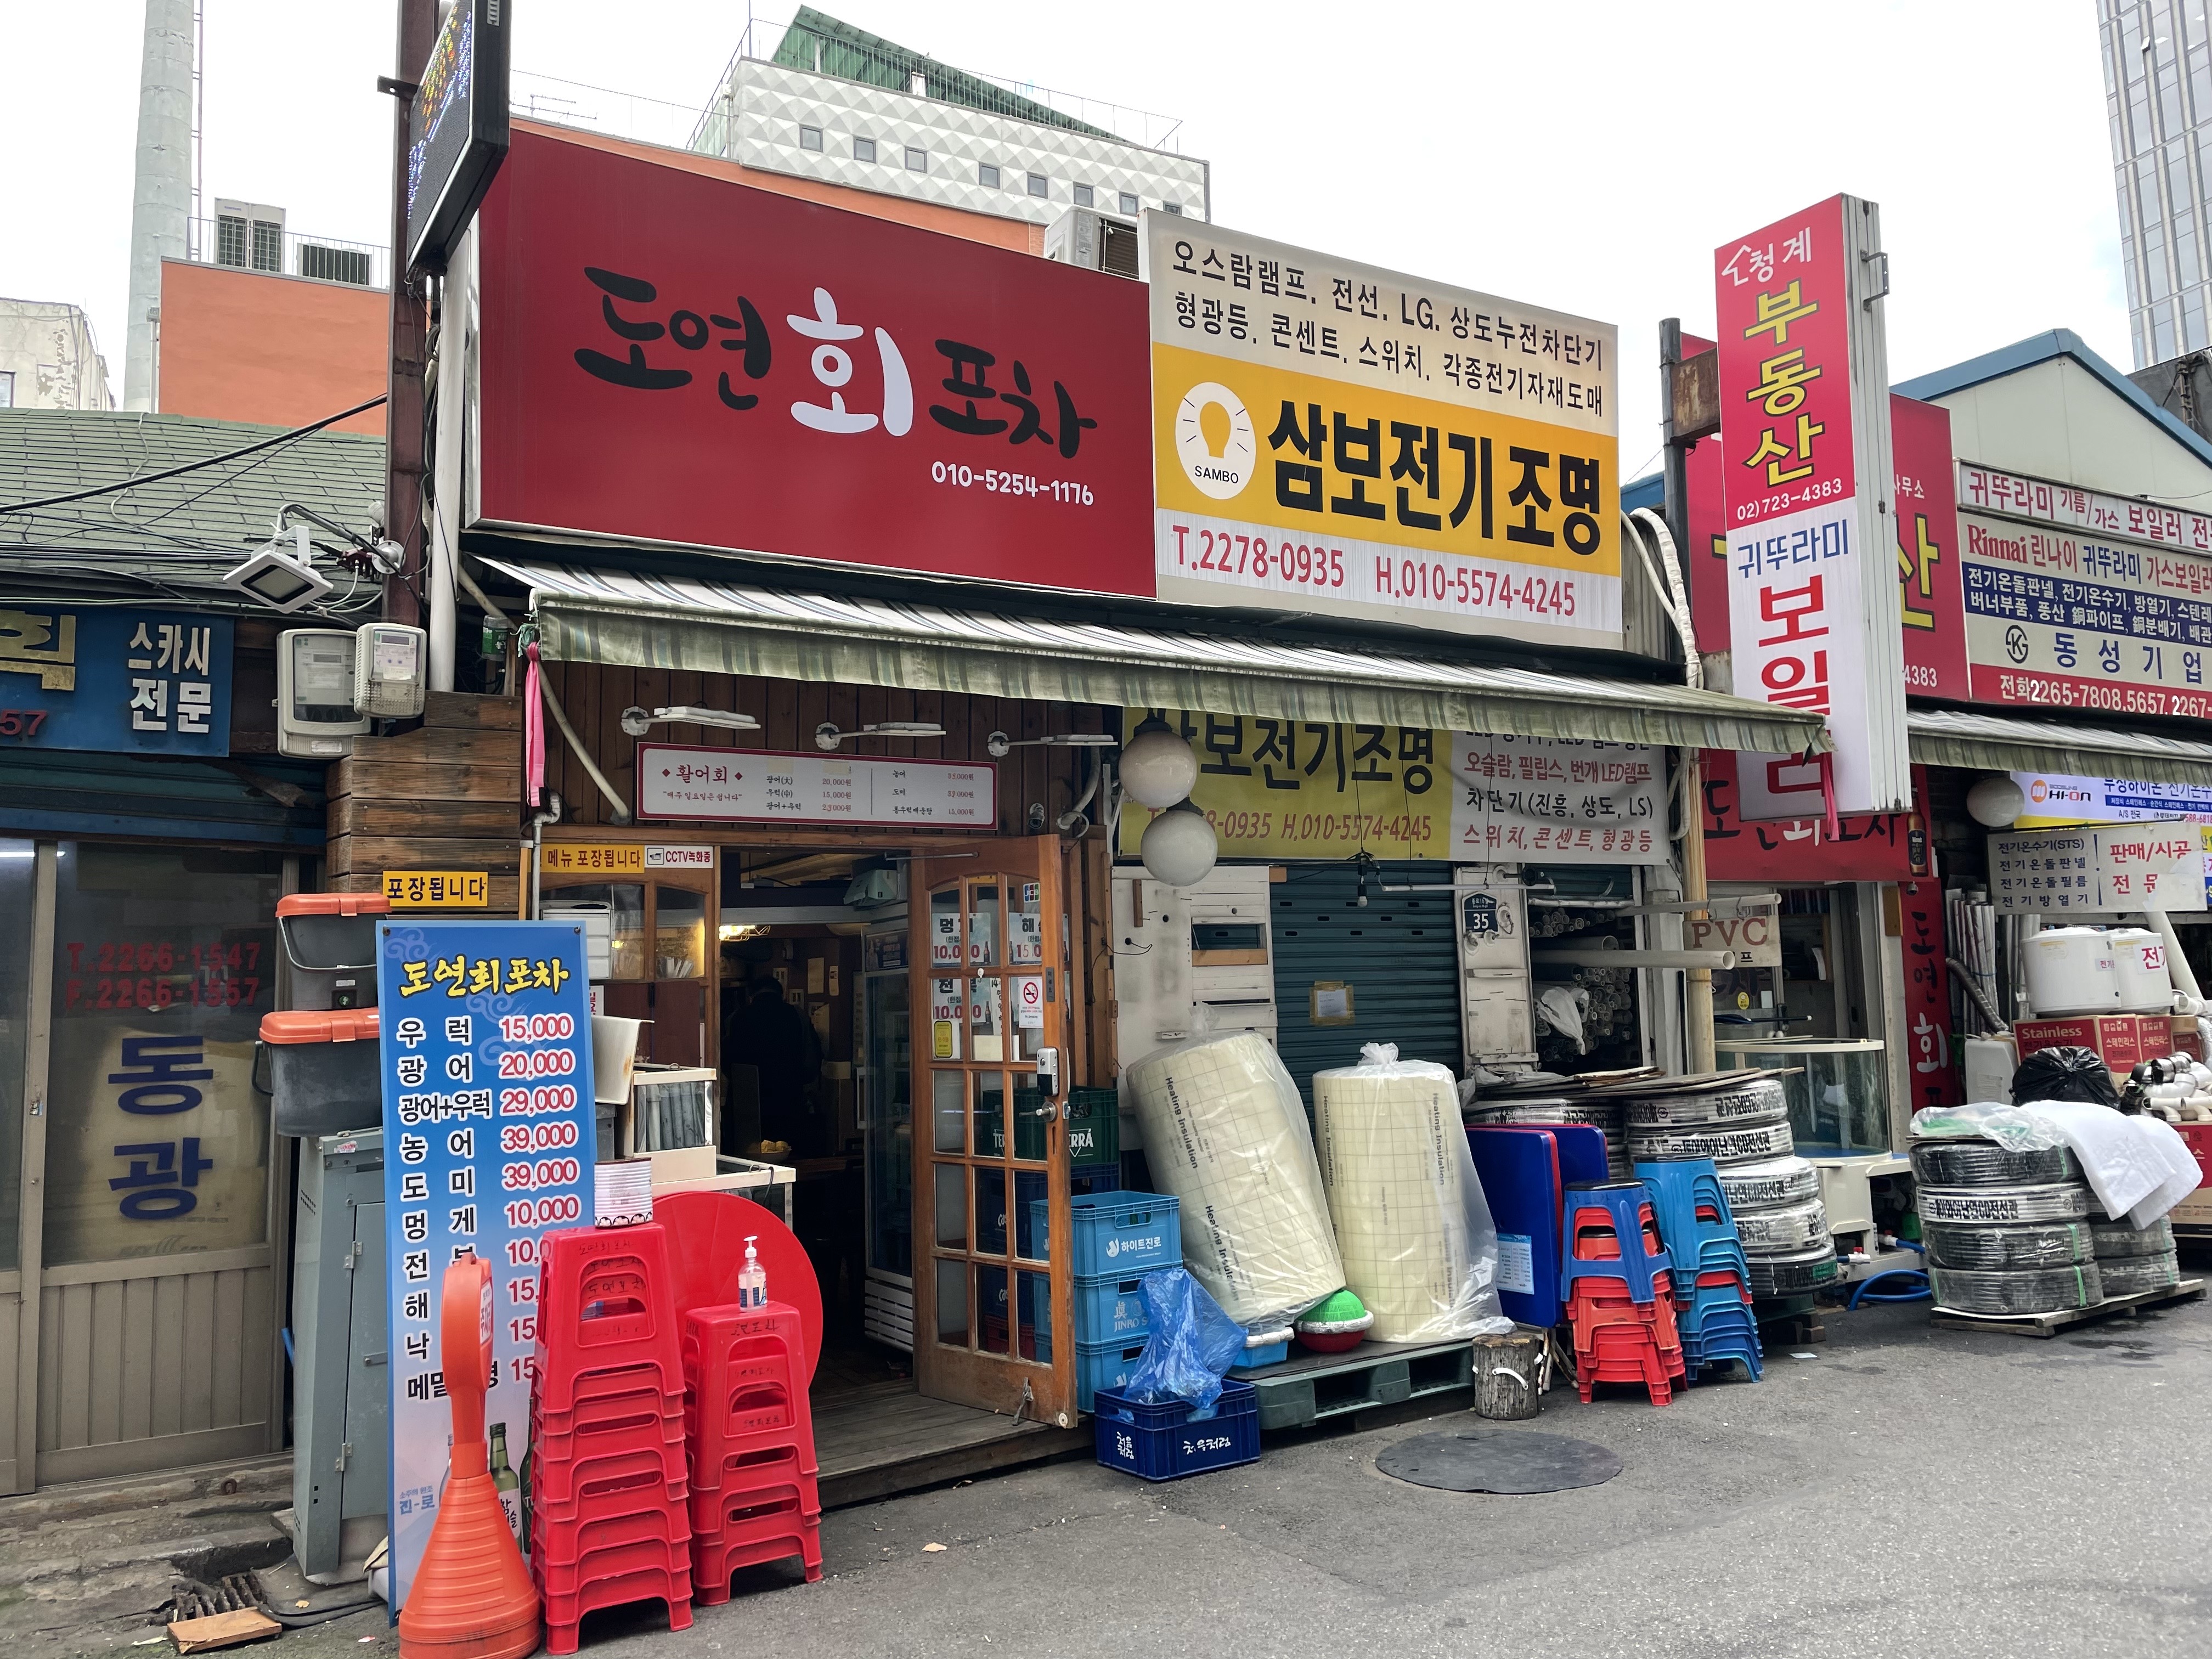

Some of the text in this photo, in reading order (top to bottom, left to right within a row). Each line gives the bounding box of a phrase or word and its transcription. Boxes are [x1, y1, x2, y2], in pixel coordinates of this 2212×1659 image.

[1750, 227, 1811, 283] 청계
[1173, 241, 1602, 371] 오스람램프. 전선. LG. 상도누전차단기
[574, 266, 1097, 459] 도연 회 포차
[1176, 291, 1602, 417] 형광등. 콘센트. 스위치. 각종전기자재도매
[1742, 277, 1825, 488] 부동산
[932, 461, 1094, 506] 010-5254-1176
[1194, 466, 1239, 485] SAMBO
[1268, 400, 1601, 555] 삼보전기조명
[1737, 478, 1842, 521] 02)723-4383
[1969, 472, 2054, 520] 귀뚜라미
[2129, 505, 2182, 544] 보일러
[2192, 517, 2212, 549] 전
[1739, 519, 1849, 578] 귀뚜라미
[1967, 524, 2028, 564] Rinnai
[2030, 534, 2078, 573] 린나이
[2083, 545, 2141, 584] 귀뚜라미
[1173, 525, 1575, 618] T.2278-0935 H.010-5574-4245
[1968, 568, 2058, 601] 전기온돌판넬,
[2062, 583, 2131, 613] 전기온수기,
[2134, 595, 2175, 620] 방열기,
[1971, 591, 2033, 621] 버너부품,
[2038, 602, 2065, 623] 풍산
[130, 622, 211, 676] 스카시
[2053, 632, 2202, 685] 동성기업
[2000, 674, 2030, 702] 전화
[130, 678, 212, 734] 전문
[1178, 709, 1433, 795] 보전기조명
[675, 764, 727, 786] 활어회
[892, 770, 906, 778] 농어
[1519, 756, 1567, 783] 필립스,
[1571, 760, 1598, 784] 번개
[1581, 795, 1621, 819] 상도,
[1629, 795, 1653, 819] LS)
[2119, 810, 2129, 818] A/S
[1281, 813, 1431, 841] H.010-5574-4245
[1464, 824, 1653, 853] 스위치, 콘센트, 형광등
[548, 848, 641, 868] 메뉴 포장됩니다
[1998, 838, 2085, 855] 전기온수기(STS)
[2110, 840, 2192, 864] 판매/시공
[2000, 857, 2086, 872] 전기온돌판넬
[387, 876, 486, 902] 포장됩니다
[2000, 876, 2088, 890] 전기온돌필름
[2001, 894, 2089, 909] 전기방열기
[1022, 917, 1041, 933] 해
[1473, 913, 1489, 929] 35
[1691, 917, 1768, 949] PVC
[66, 942, 261, 973] T.2266-1547
[399, 955, 569, 998] 도연회포차
[65, 976, 259, 1009] F.2266-1557
[501, 1015, 572, 1041] 15,000
[2022, 1026, 2083, 1039] Stainless
[501, 1051, 573, 1077] 20,000
[401, 1091, 490, 1123] 광어+우럭
[502, 1087, 574, 1115] 29,000
[108, 1036, 213, 1220] 동광
[503, 1123, 576, 1152] 39,000
[1165, 1076, 1182, 1116] Heating
[1178, 1118, 1199, 1170] Insulation
[1435, 1130, 1445, 1186] Insulation
[504, 1159, 578, 1189] 39,000
[507, 1197, 579, 1227] 10,000
[1121, 1236, 1161, 1252] 하이트진로
[1114, 1317, 1139, 1332] JINRO
[399, 1485, 433, 1499] 소주의 원조
